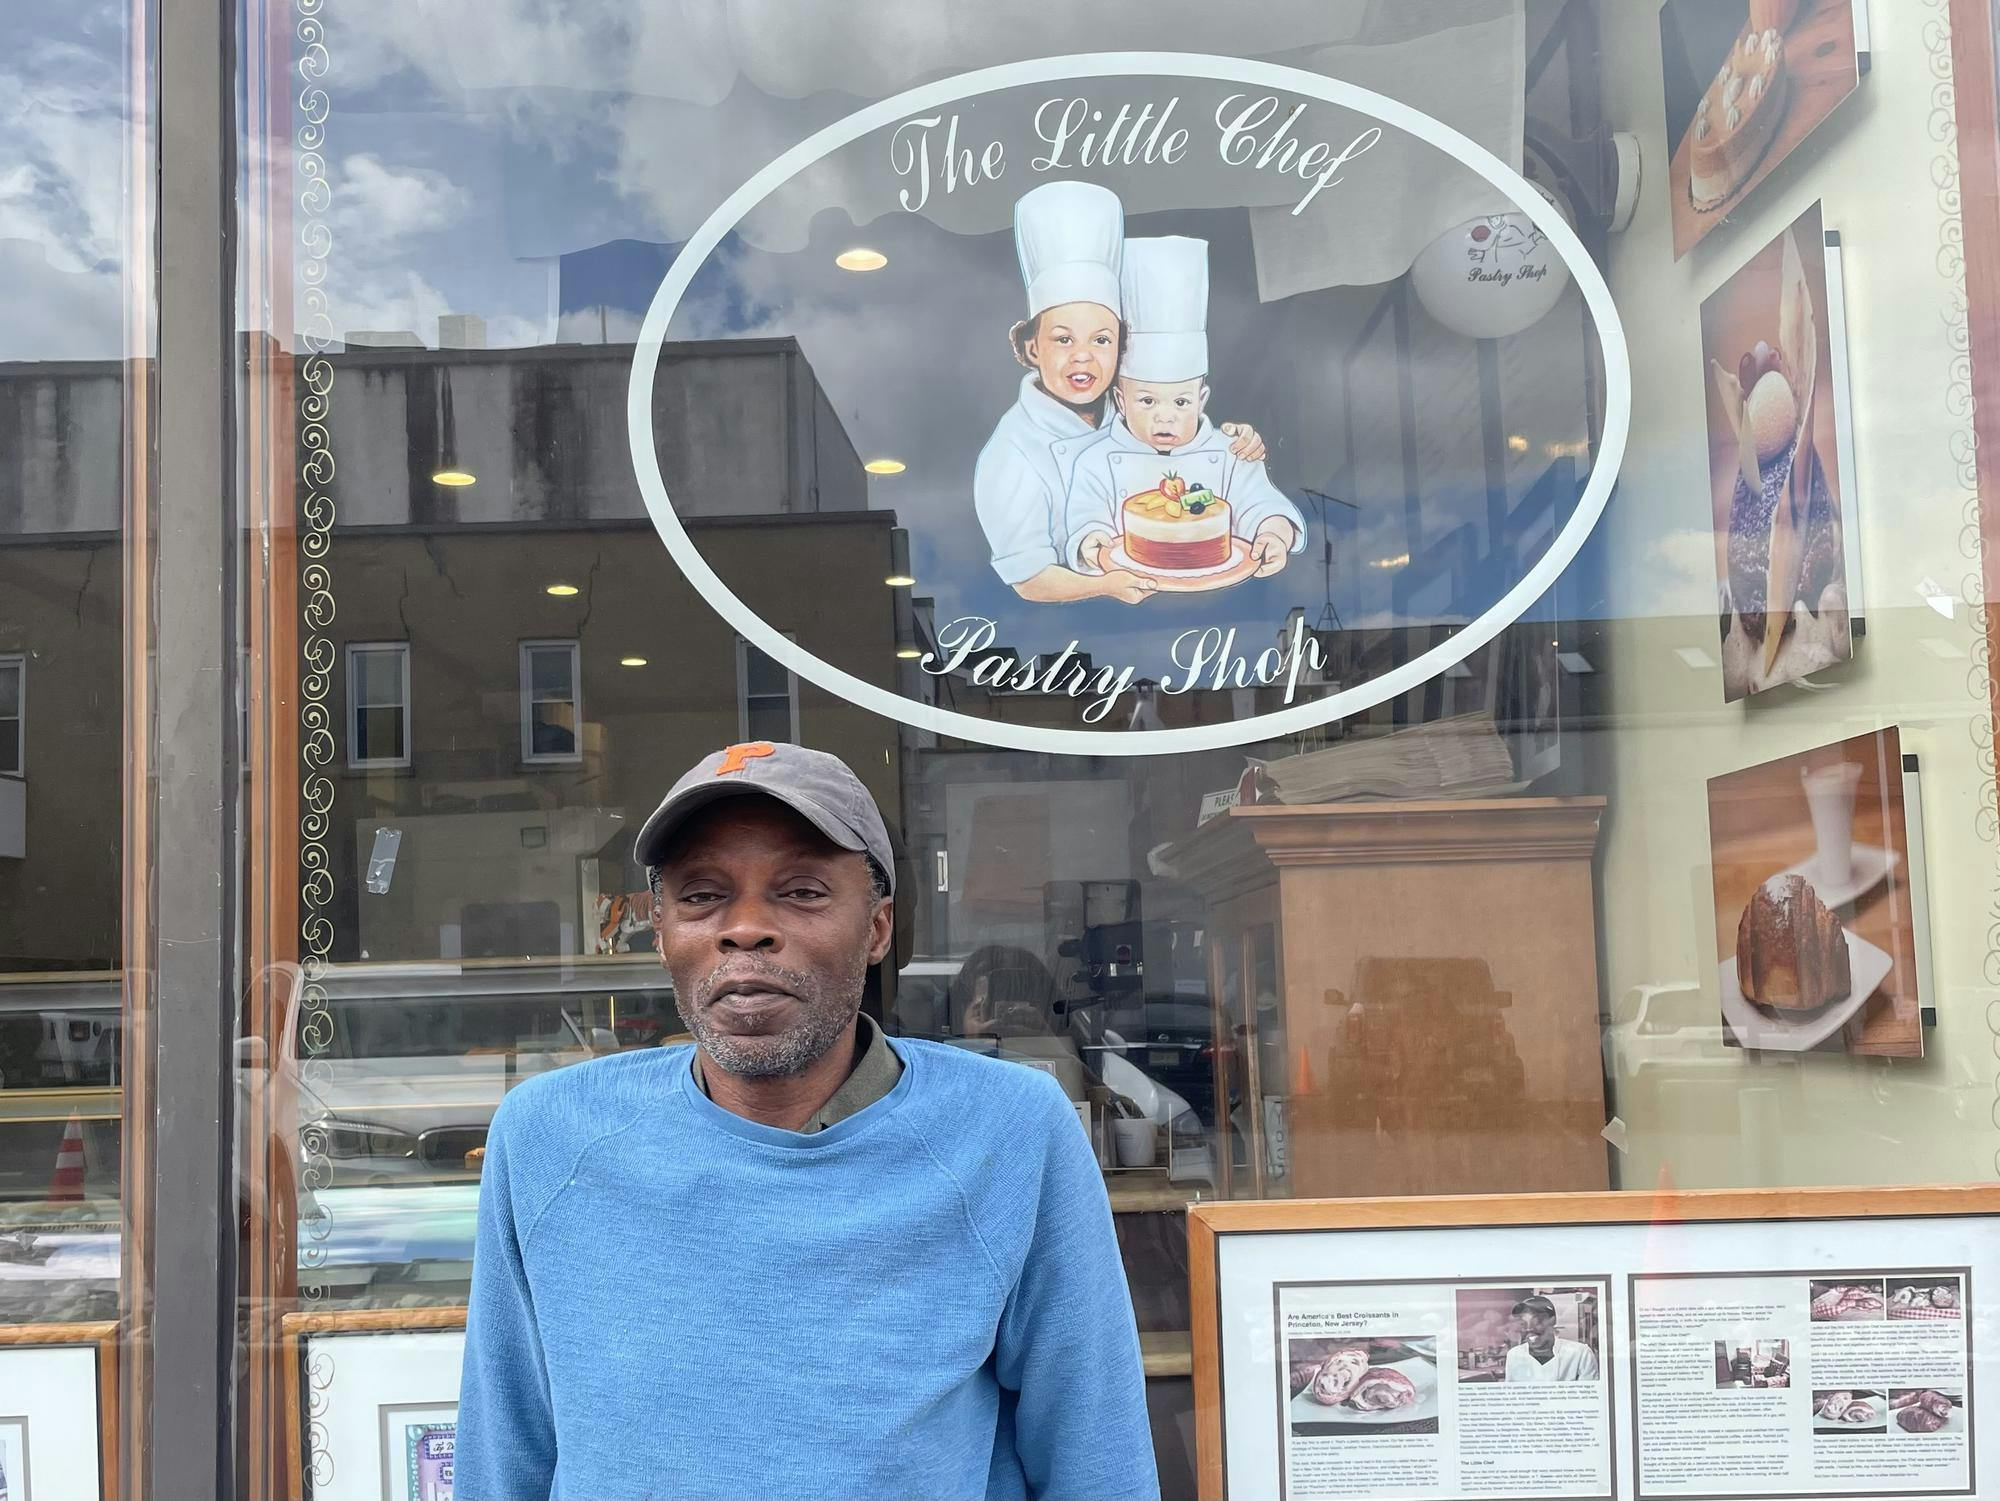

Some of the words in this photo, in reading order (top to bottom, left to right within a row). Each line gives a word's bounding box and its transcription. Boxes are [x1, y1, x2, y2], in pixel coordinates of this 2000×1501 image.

[890, 114, 1006, 212] The
[1031, 97, 1190, 171] Little
[1214, 94, 1382, 216] Chef
[1468, 267, 1512, 287] Pastry
[1516, 264, 1547, 281] Shop
[920, 616, 1135, 723] Pastry
[1160, 616, 1328, 705] Shop
[716, 741, 776, 776] P
[1214, 793, 1236, 807] PLEAS
[1341, 1320, 1368, 1328] Jersey?
